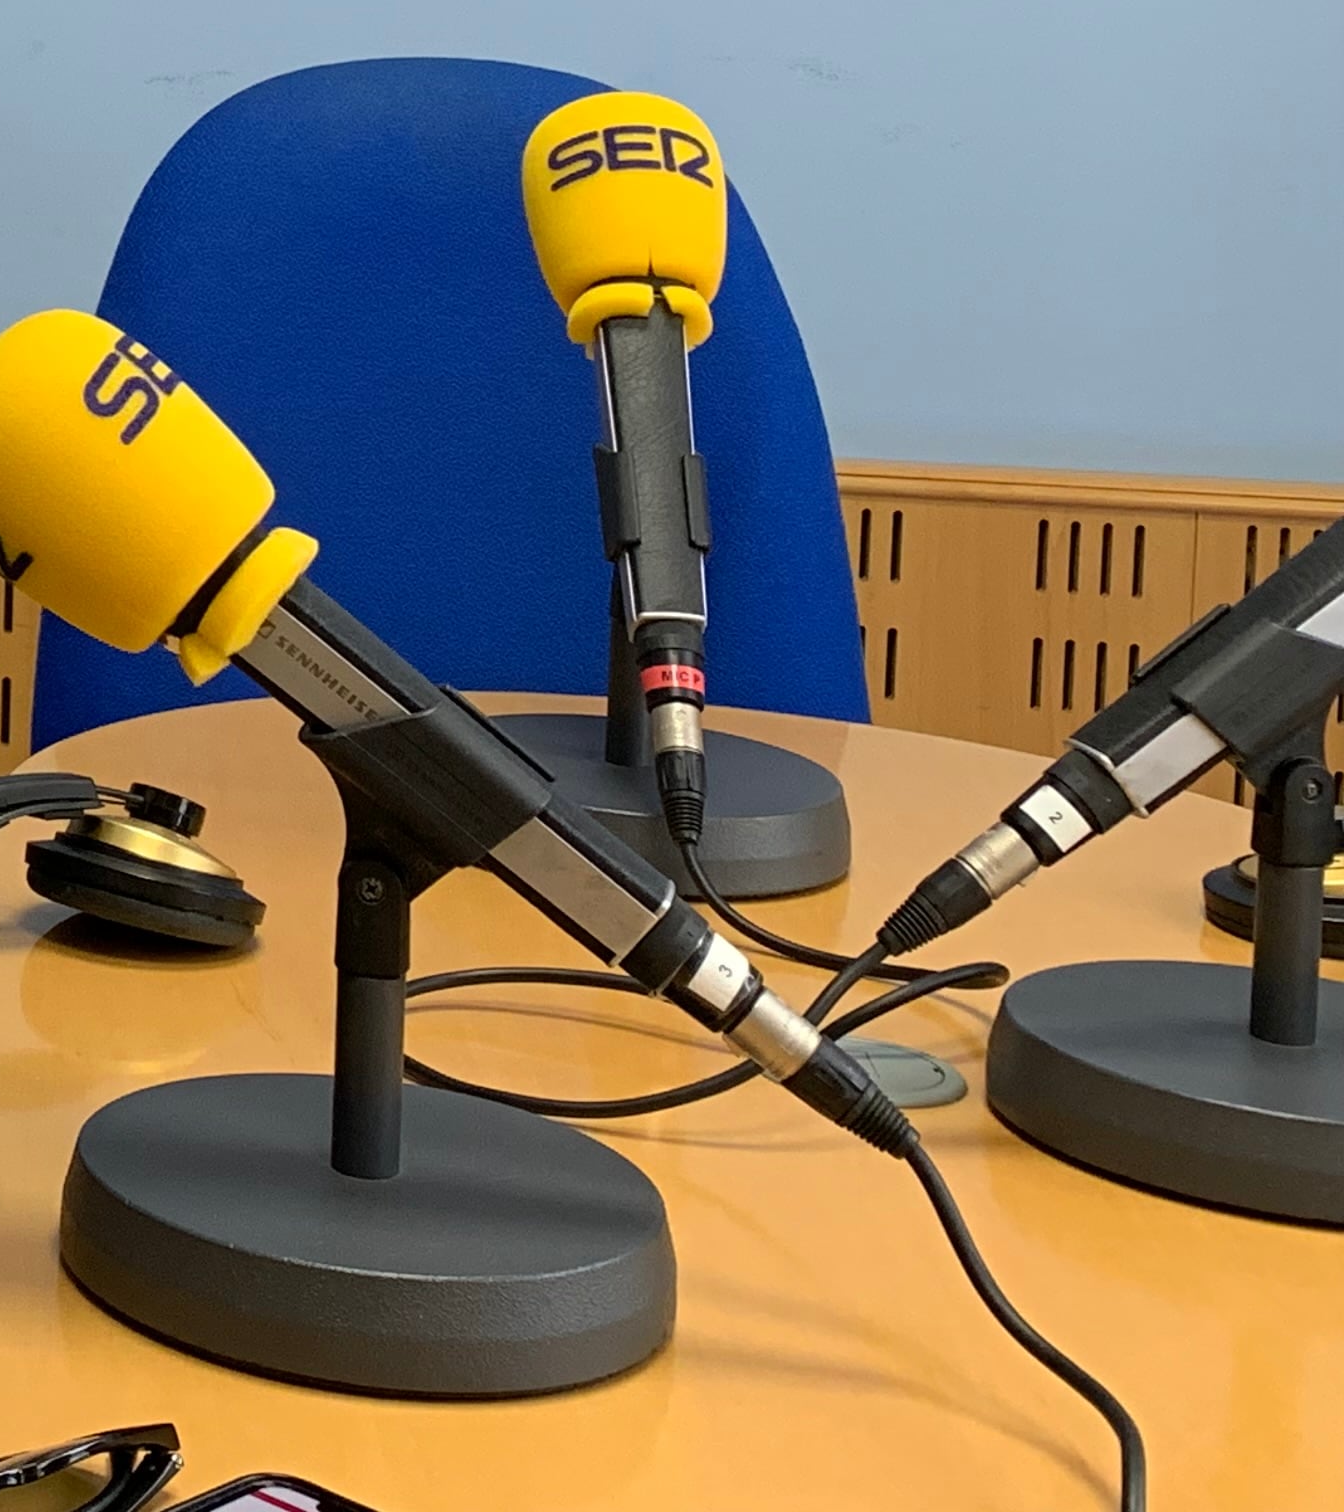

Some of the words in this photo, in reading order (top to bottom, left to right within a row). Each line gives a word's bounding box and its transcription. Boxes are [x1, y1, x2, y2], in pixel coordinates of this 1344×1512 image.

[547, 125, 714, 192] SER
[275, 636, 381, 722] SENNHEISE
[1048, 811, 1063, 824] 2
[719, 964, 732, 977] 3
